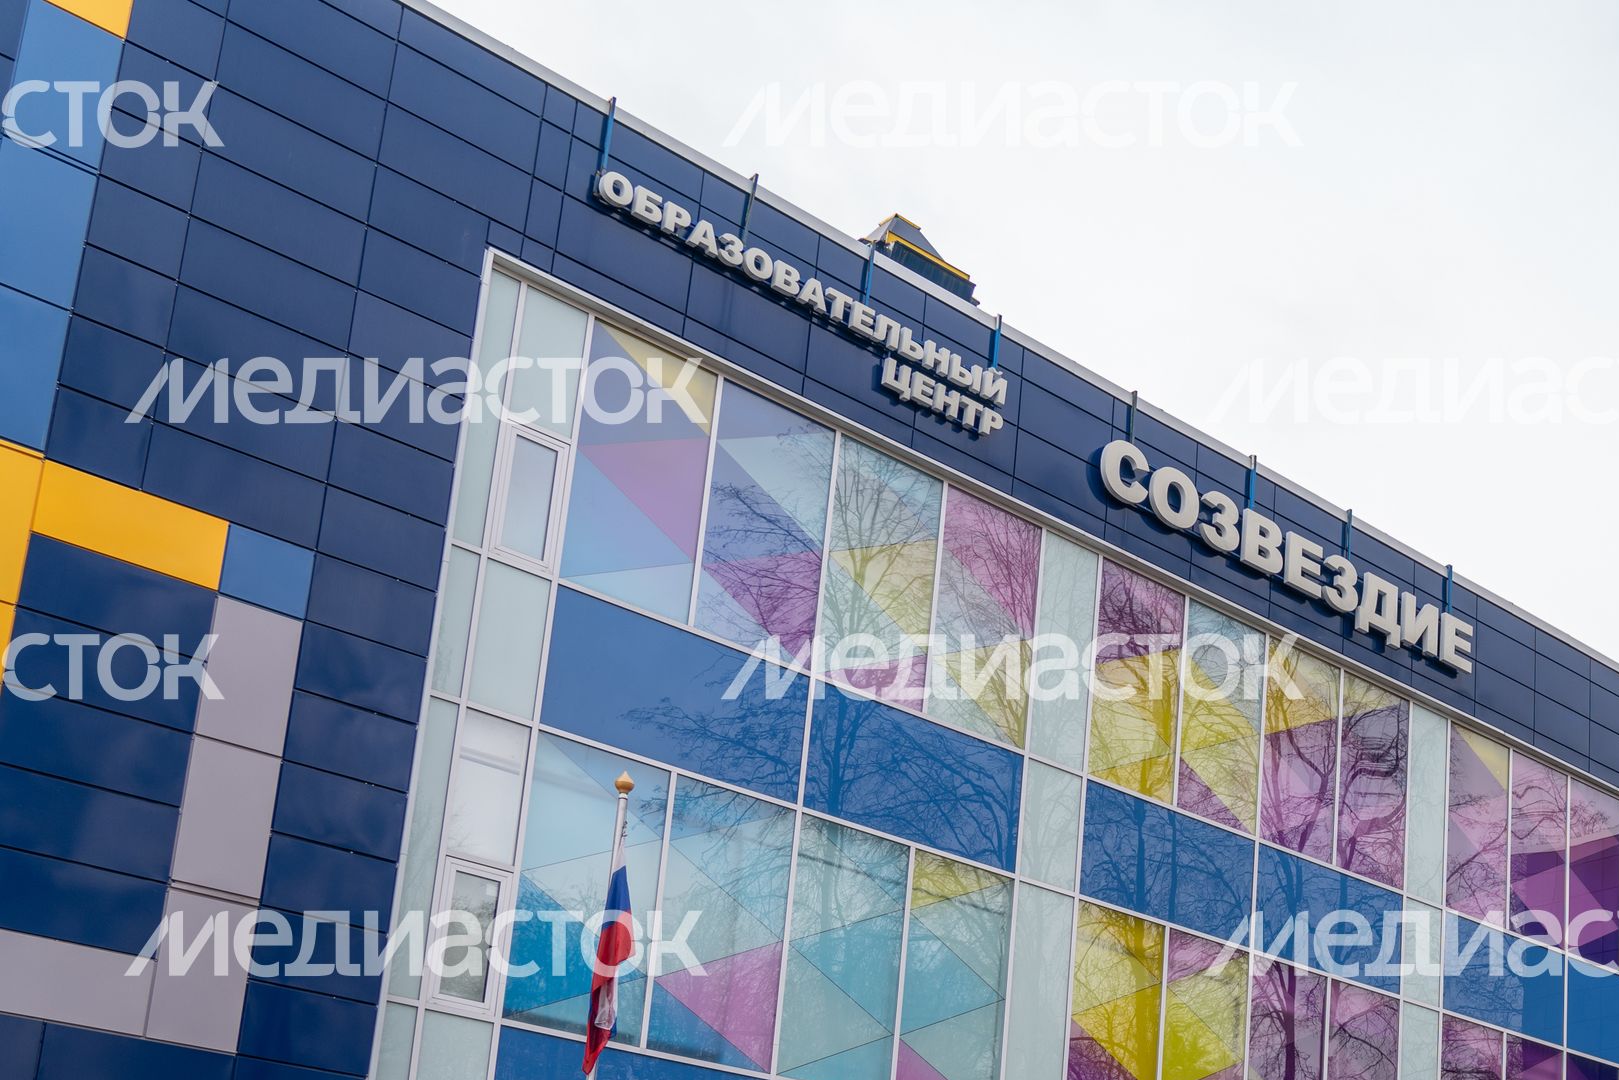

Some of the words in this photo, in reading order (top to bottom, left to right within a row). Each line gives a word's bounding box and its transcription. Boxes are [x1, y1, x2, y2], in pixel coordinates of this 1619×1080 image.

[599, 171, 1008, 405] ОБРАЗОВАТЕЛЬНЫЙ
[881, 358, 1004, 436] ЦЕНТР
[1100, 439, 1474, 674] СОЗВЕЗДИЕ
